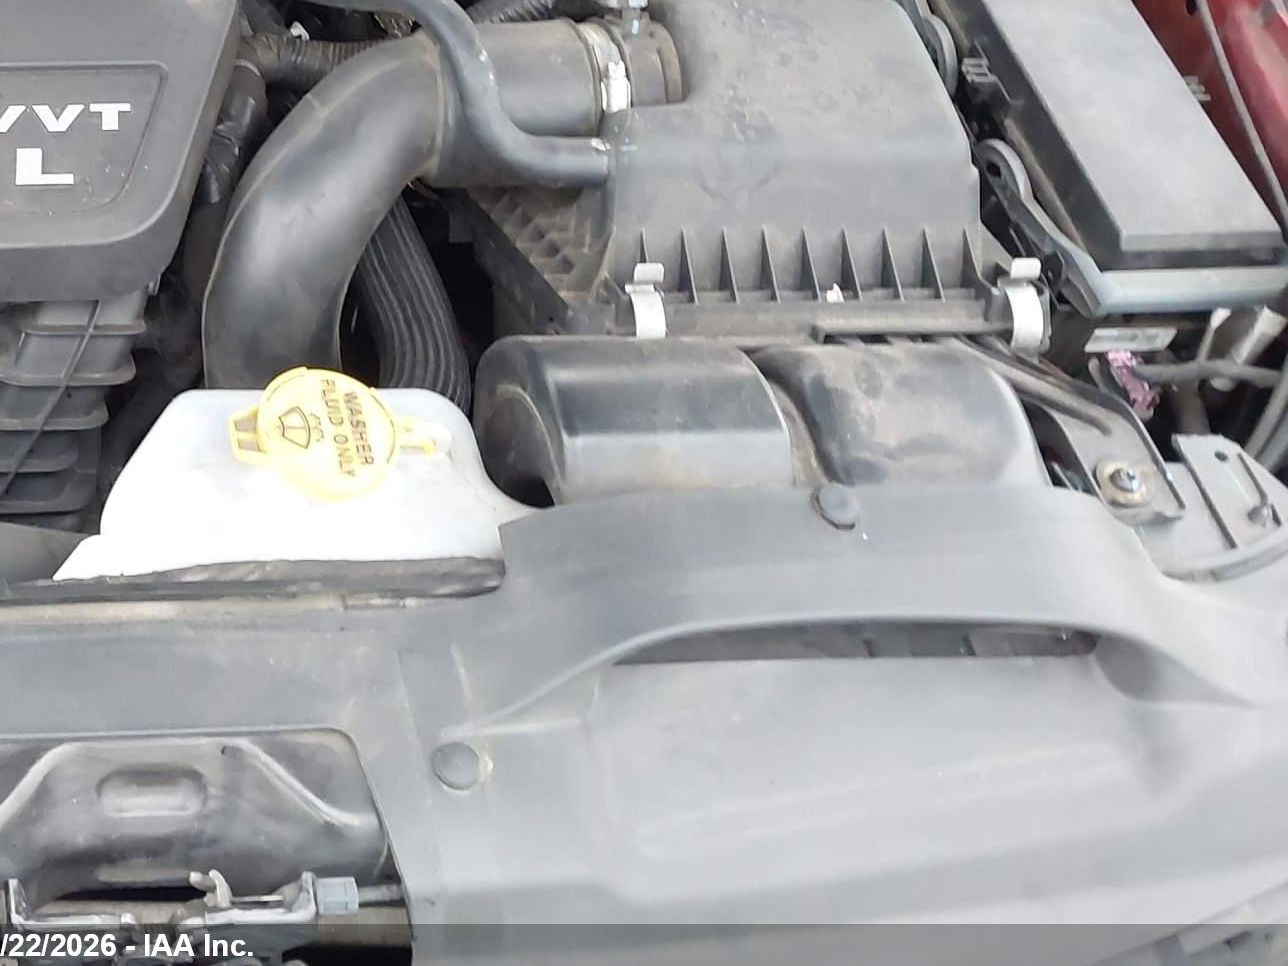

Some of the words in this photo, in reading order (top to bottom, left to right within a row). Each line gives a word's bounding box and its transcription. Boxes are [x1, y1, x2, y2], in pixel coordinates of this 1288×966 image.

[14, 147, 75, 186] L
[320, 378, 345, 427] FLUID
[333, 434, 357, 478] ONLY
[344, 391, 375, 466] WASHER
